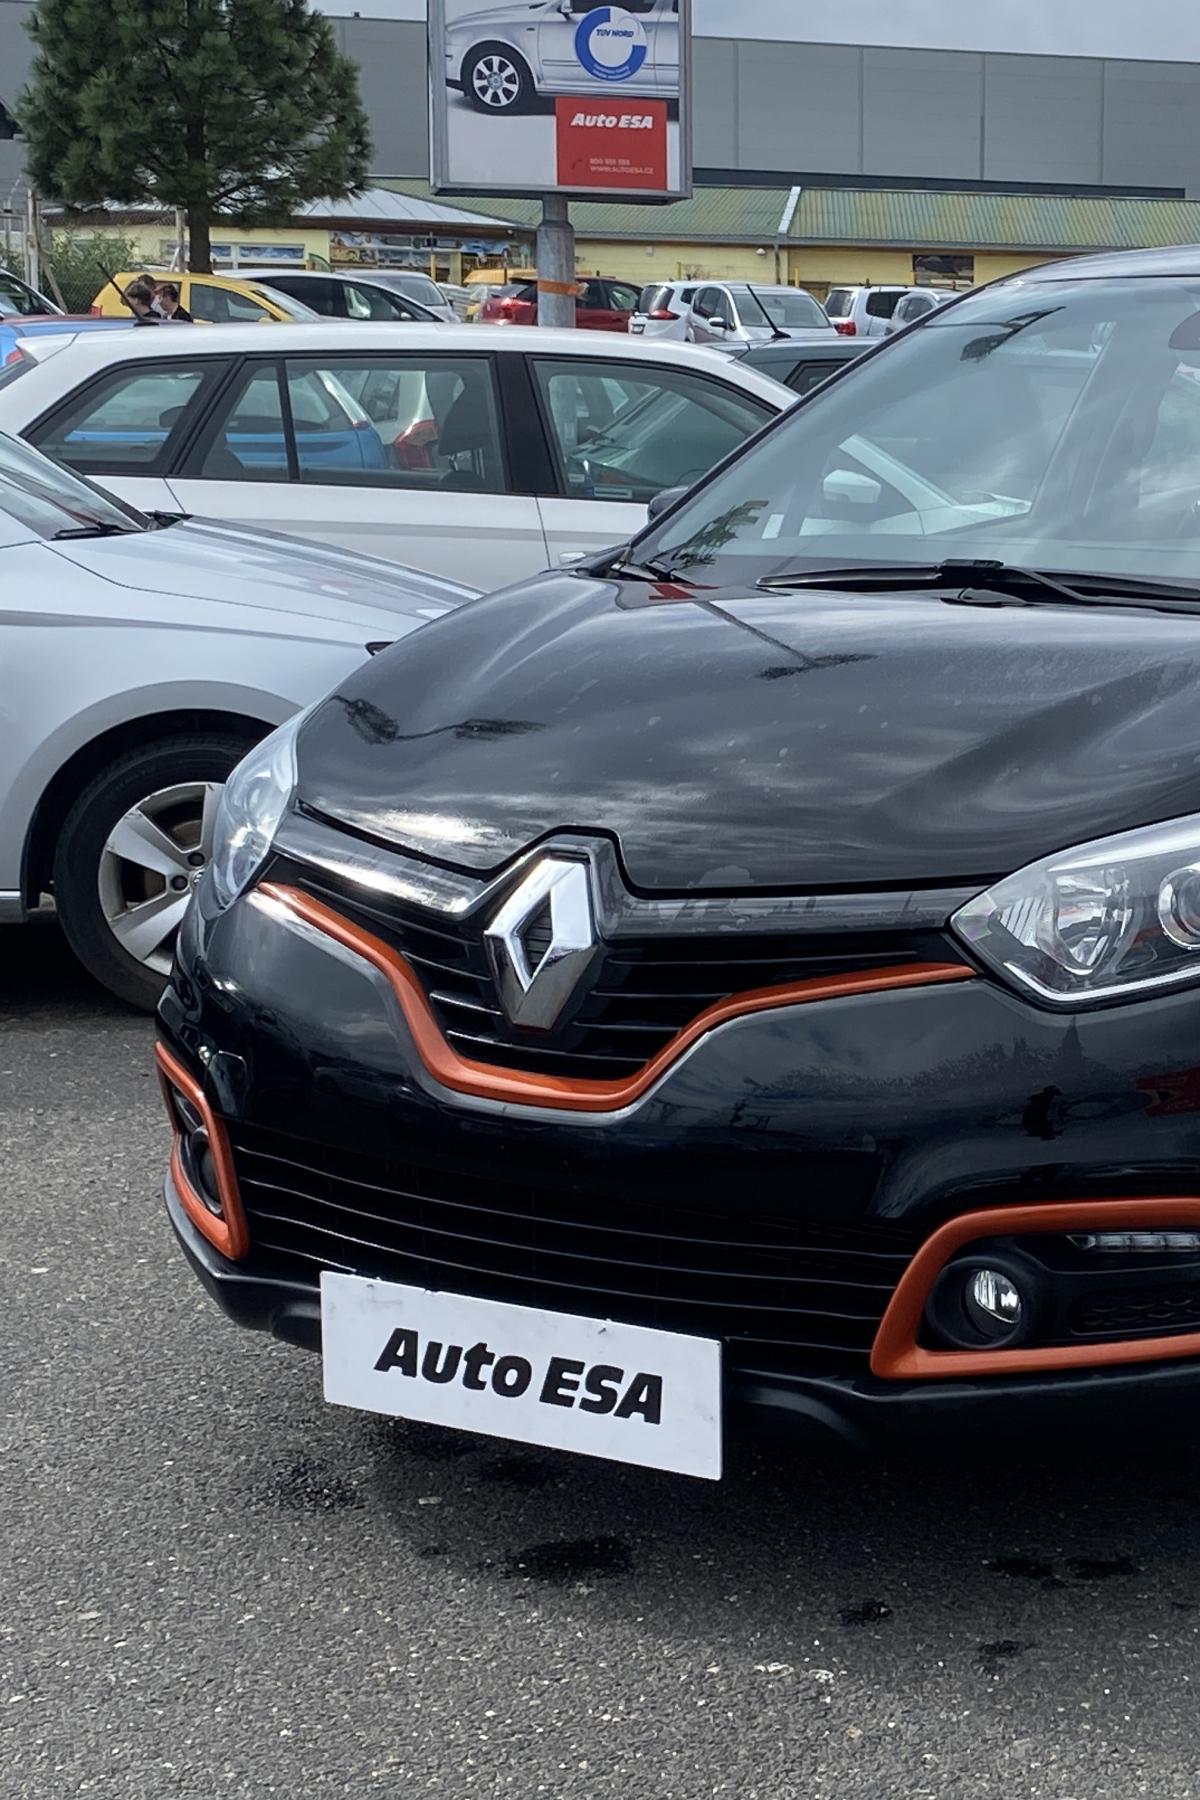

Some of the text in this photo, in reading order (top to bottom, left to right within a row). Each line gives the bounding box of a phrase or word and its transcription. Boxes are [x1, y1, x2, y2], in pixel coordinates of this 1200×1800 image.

[611, 30, 634, 38] NORD
[570, 113, 653, 129] Auto ESA
[374, 1328, 663, 1425] Auto ESA
